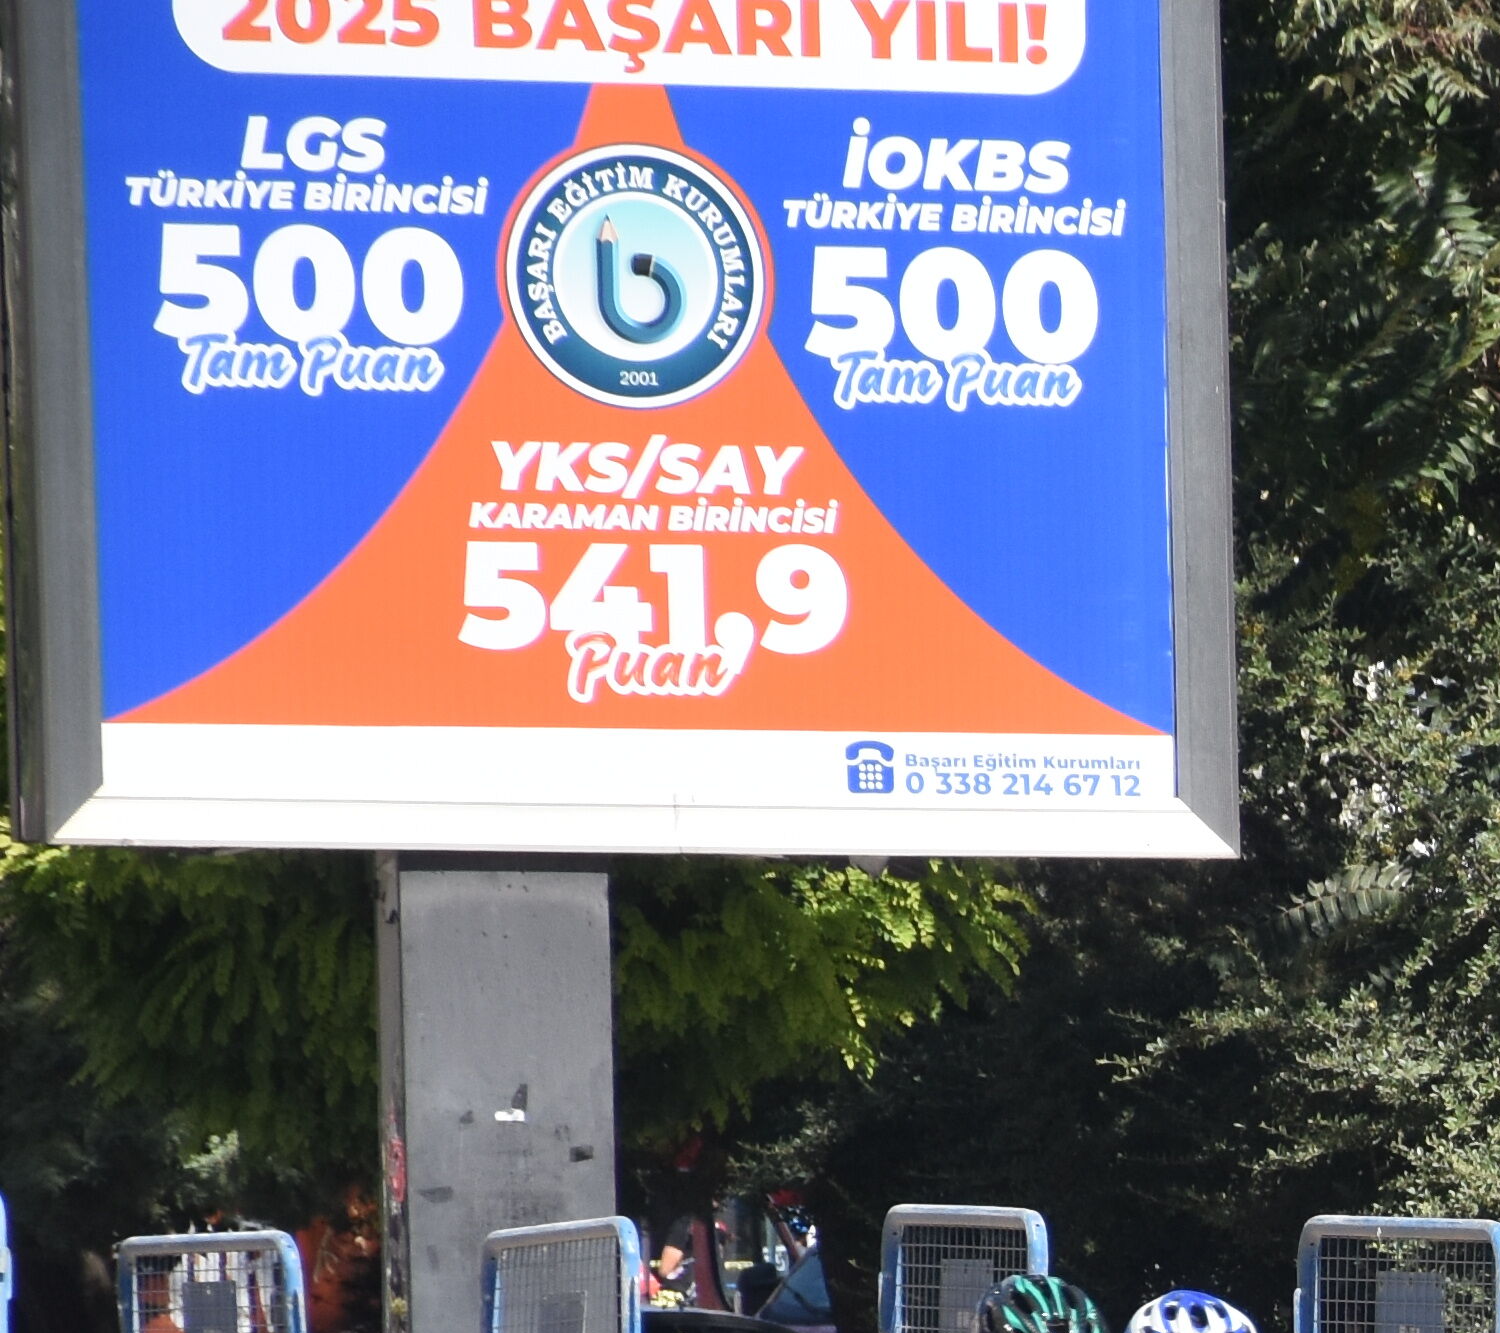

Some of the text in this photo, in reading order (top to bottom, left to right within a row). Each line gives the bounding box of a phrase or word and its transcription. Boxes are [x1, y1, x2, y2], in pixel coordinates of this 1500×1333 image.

[221, 0, 1048, 73] 2025 BAŞARI YILI!
[240, 115, 388, 173] LGS
[843, 117, 1071, 194] İOKBS
[125, 169, 489, 215] TÜRKİYE BİRİNCİSİ
[783, 192, 1127, 237] TÜRKİYE BİRİNCİSİ
[153, 223, 464, 345] 500
[526, 161, 746, 350] BAŞARI EĞİTİM KURUMLARI
[804, 246, 1099, 364] 500
[180, 332, 444, 395] Tam Puan
[619, 371, 659, 386] 2001
[834, 350, 1082, 411] Tam Puan
[490, 434, 804, 499] YKS/SAY
[469, 497, 839, 534] KARAMAN BİRİNCİSİ
[457, 541, 848, 676] 541,9
[567, 631, 732, 702] Puan
[905, 772, 1141, 797] 0 338 214 67 12
[973, 753, 1036, 771] Eğitim
